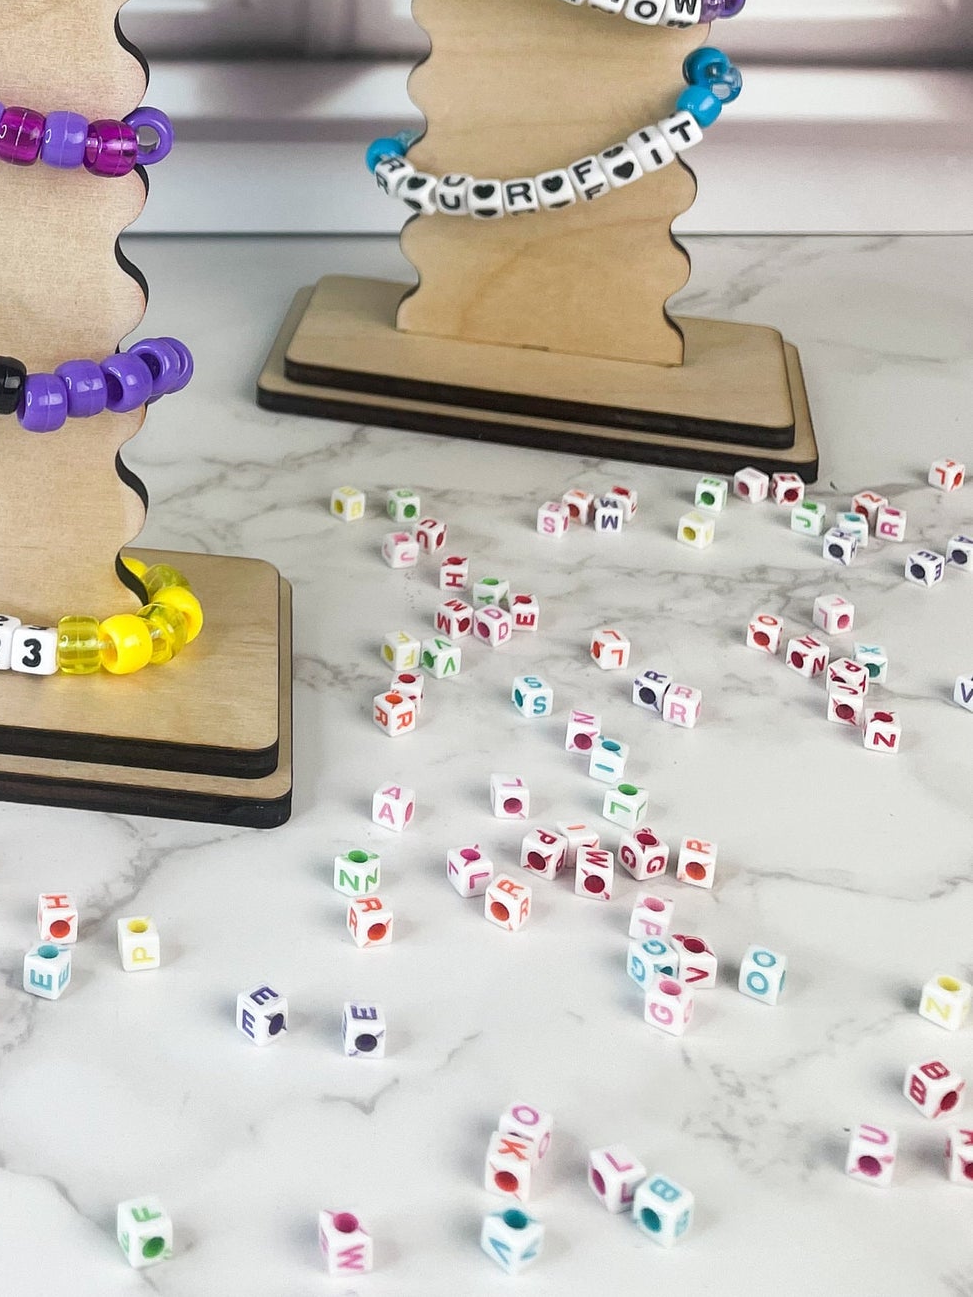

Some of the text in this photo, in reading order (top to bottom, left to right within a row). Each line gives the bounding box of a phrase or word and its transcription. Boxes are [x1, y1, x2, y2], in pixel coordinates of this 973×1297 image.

[668, 701, 689, 724] R
[30, 967, 53, 992] E
[746, 971, 769, 996] O
[249, 986, 280, 1006] E
[511, 1104, 541, 1127] O
[648, 1178, 682, 1203] B
